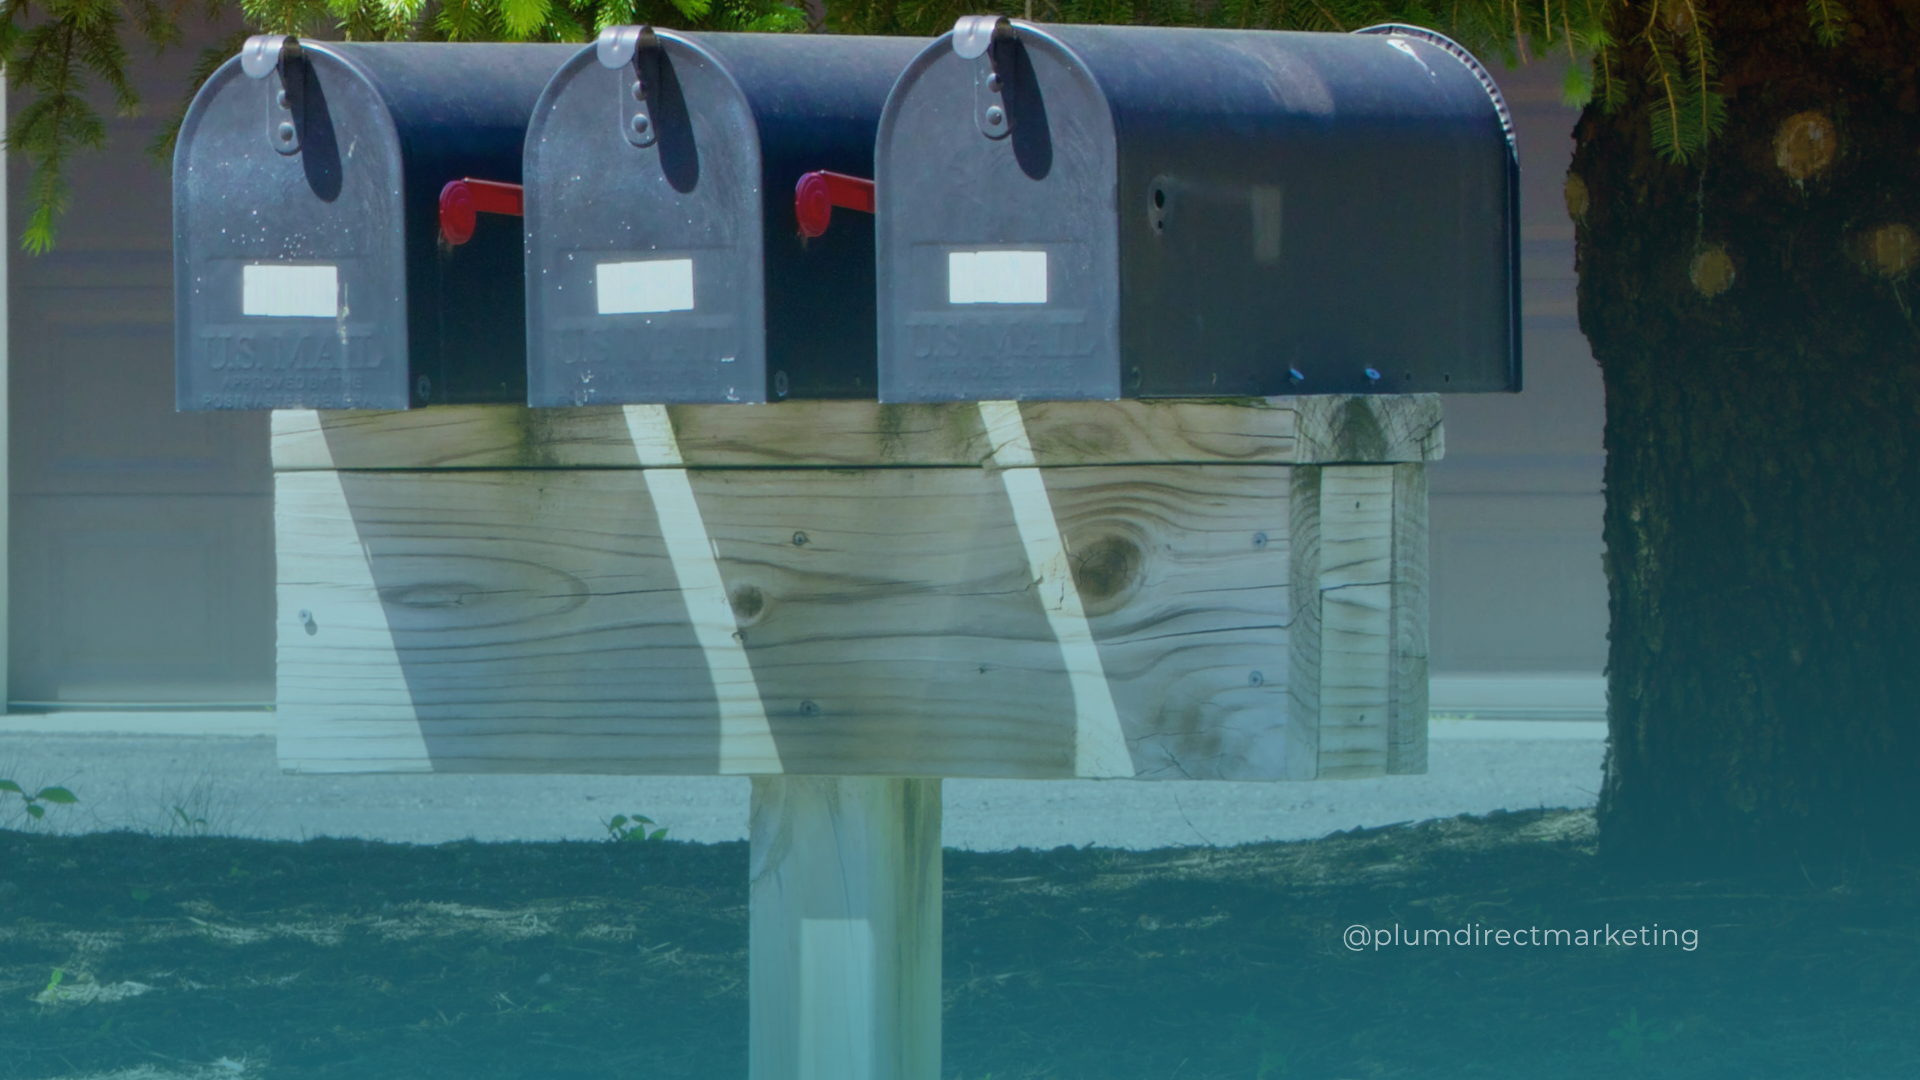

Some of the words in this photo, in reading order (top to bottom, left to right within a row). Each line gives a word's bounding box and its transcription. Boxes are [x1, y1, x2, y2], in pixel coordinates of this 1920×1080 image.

[200, 333, 263, 370] U.S.
[272, 333, 385, 370] MAIL
[221, 374, 306, 391] APPROVED
[309, 374, 328, 390] BY
